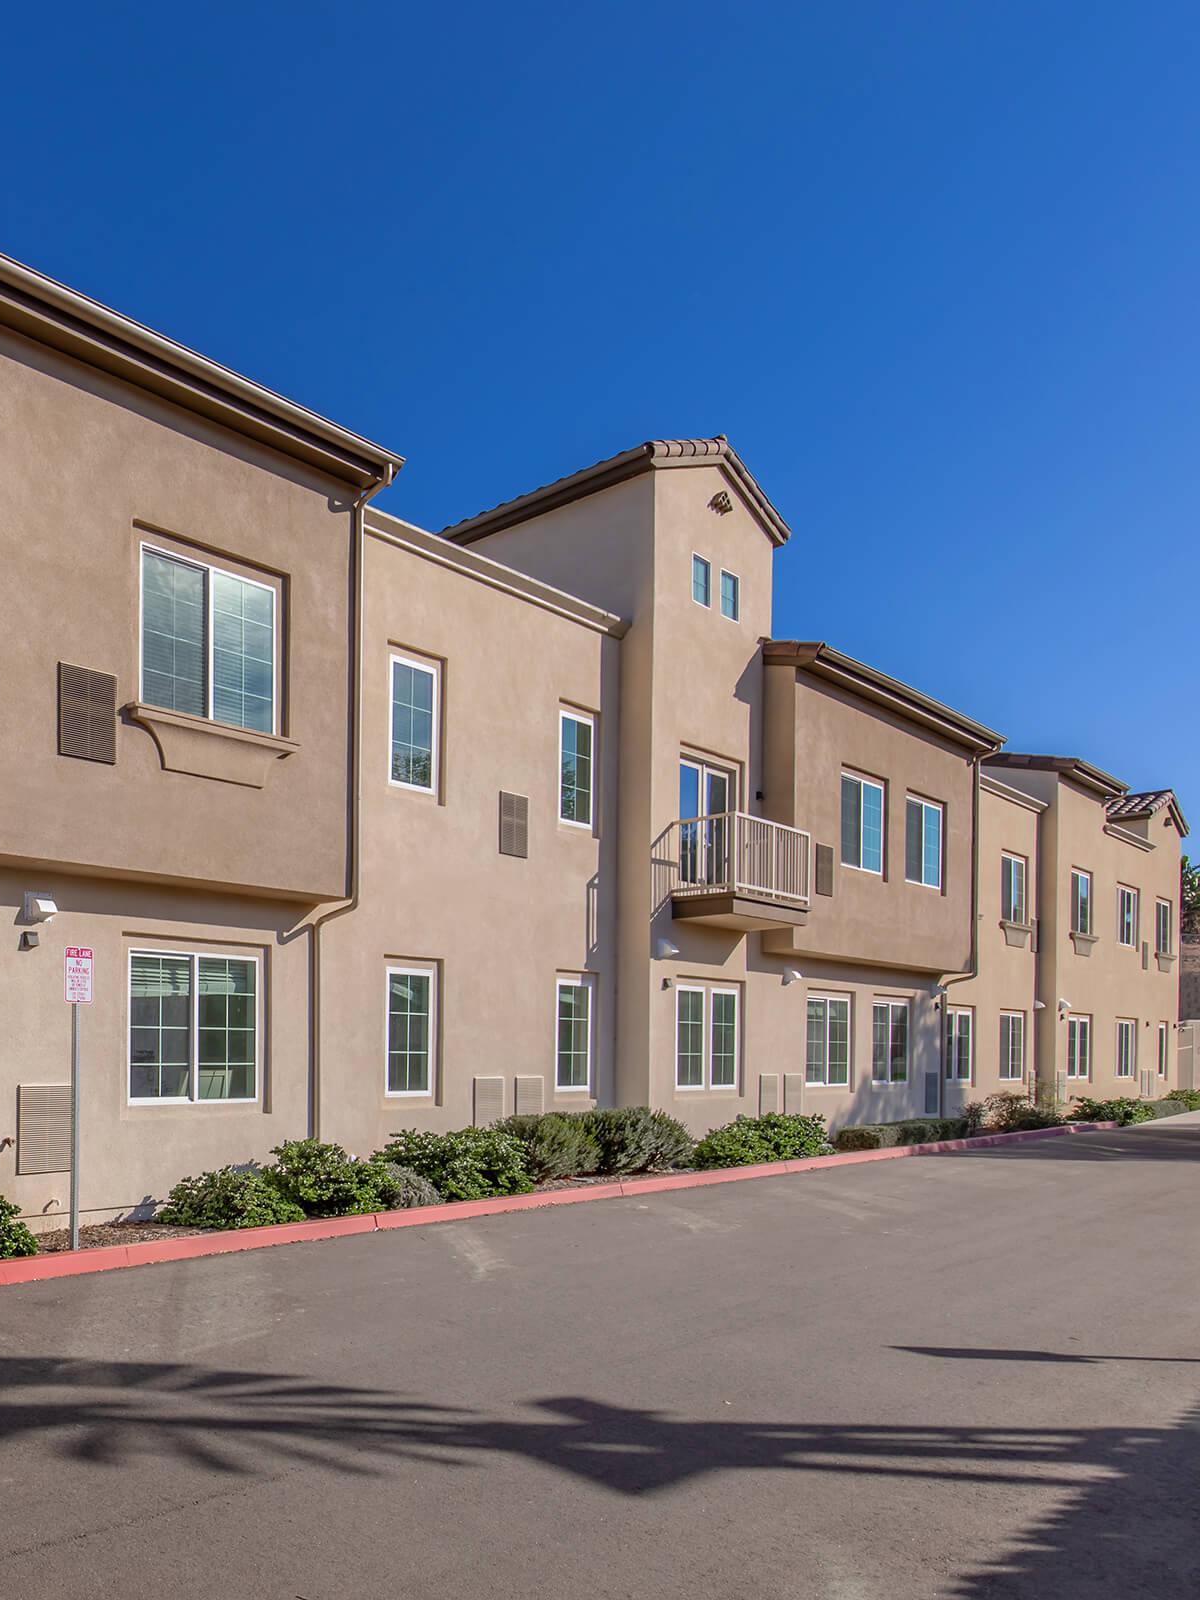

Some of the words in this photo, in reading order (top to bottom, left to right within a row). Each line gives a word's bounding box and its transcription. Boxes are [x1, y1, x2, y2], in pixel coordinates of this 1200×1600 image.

[66, 949, 78, 957] FIRE
[79, 950, 92, 958] LANE
[68, 967, 89, 975] PARKING
